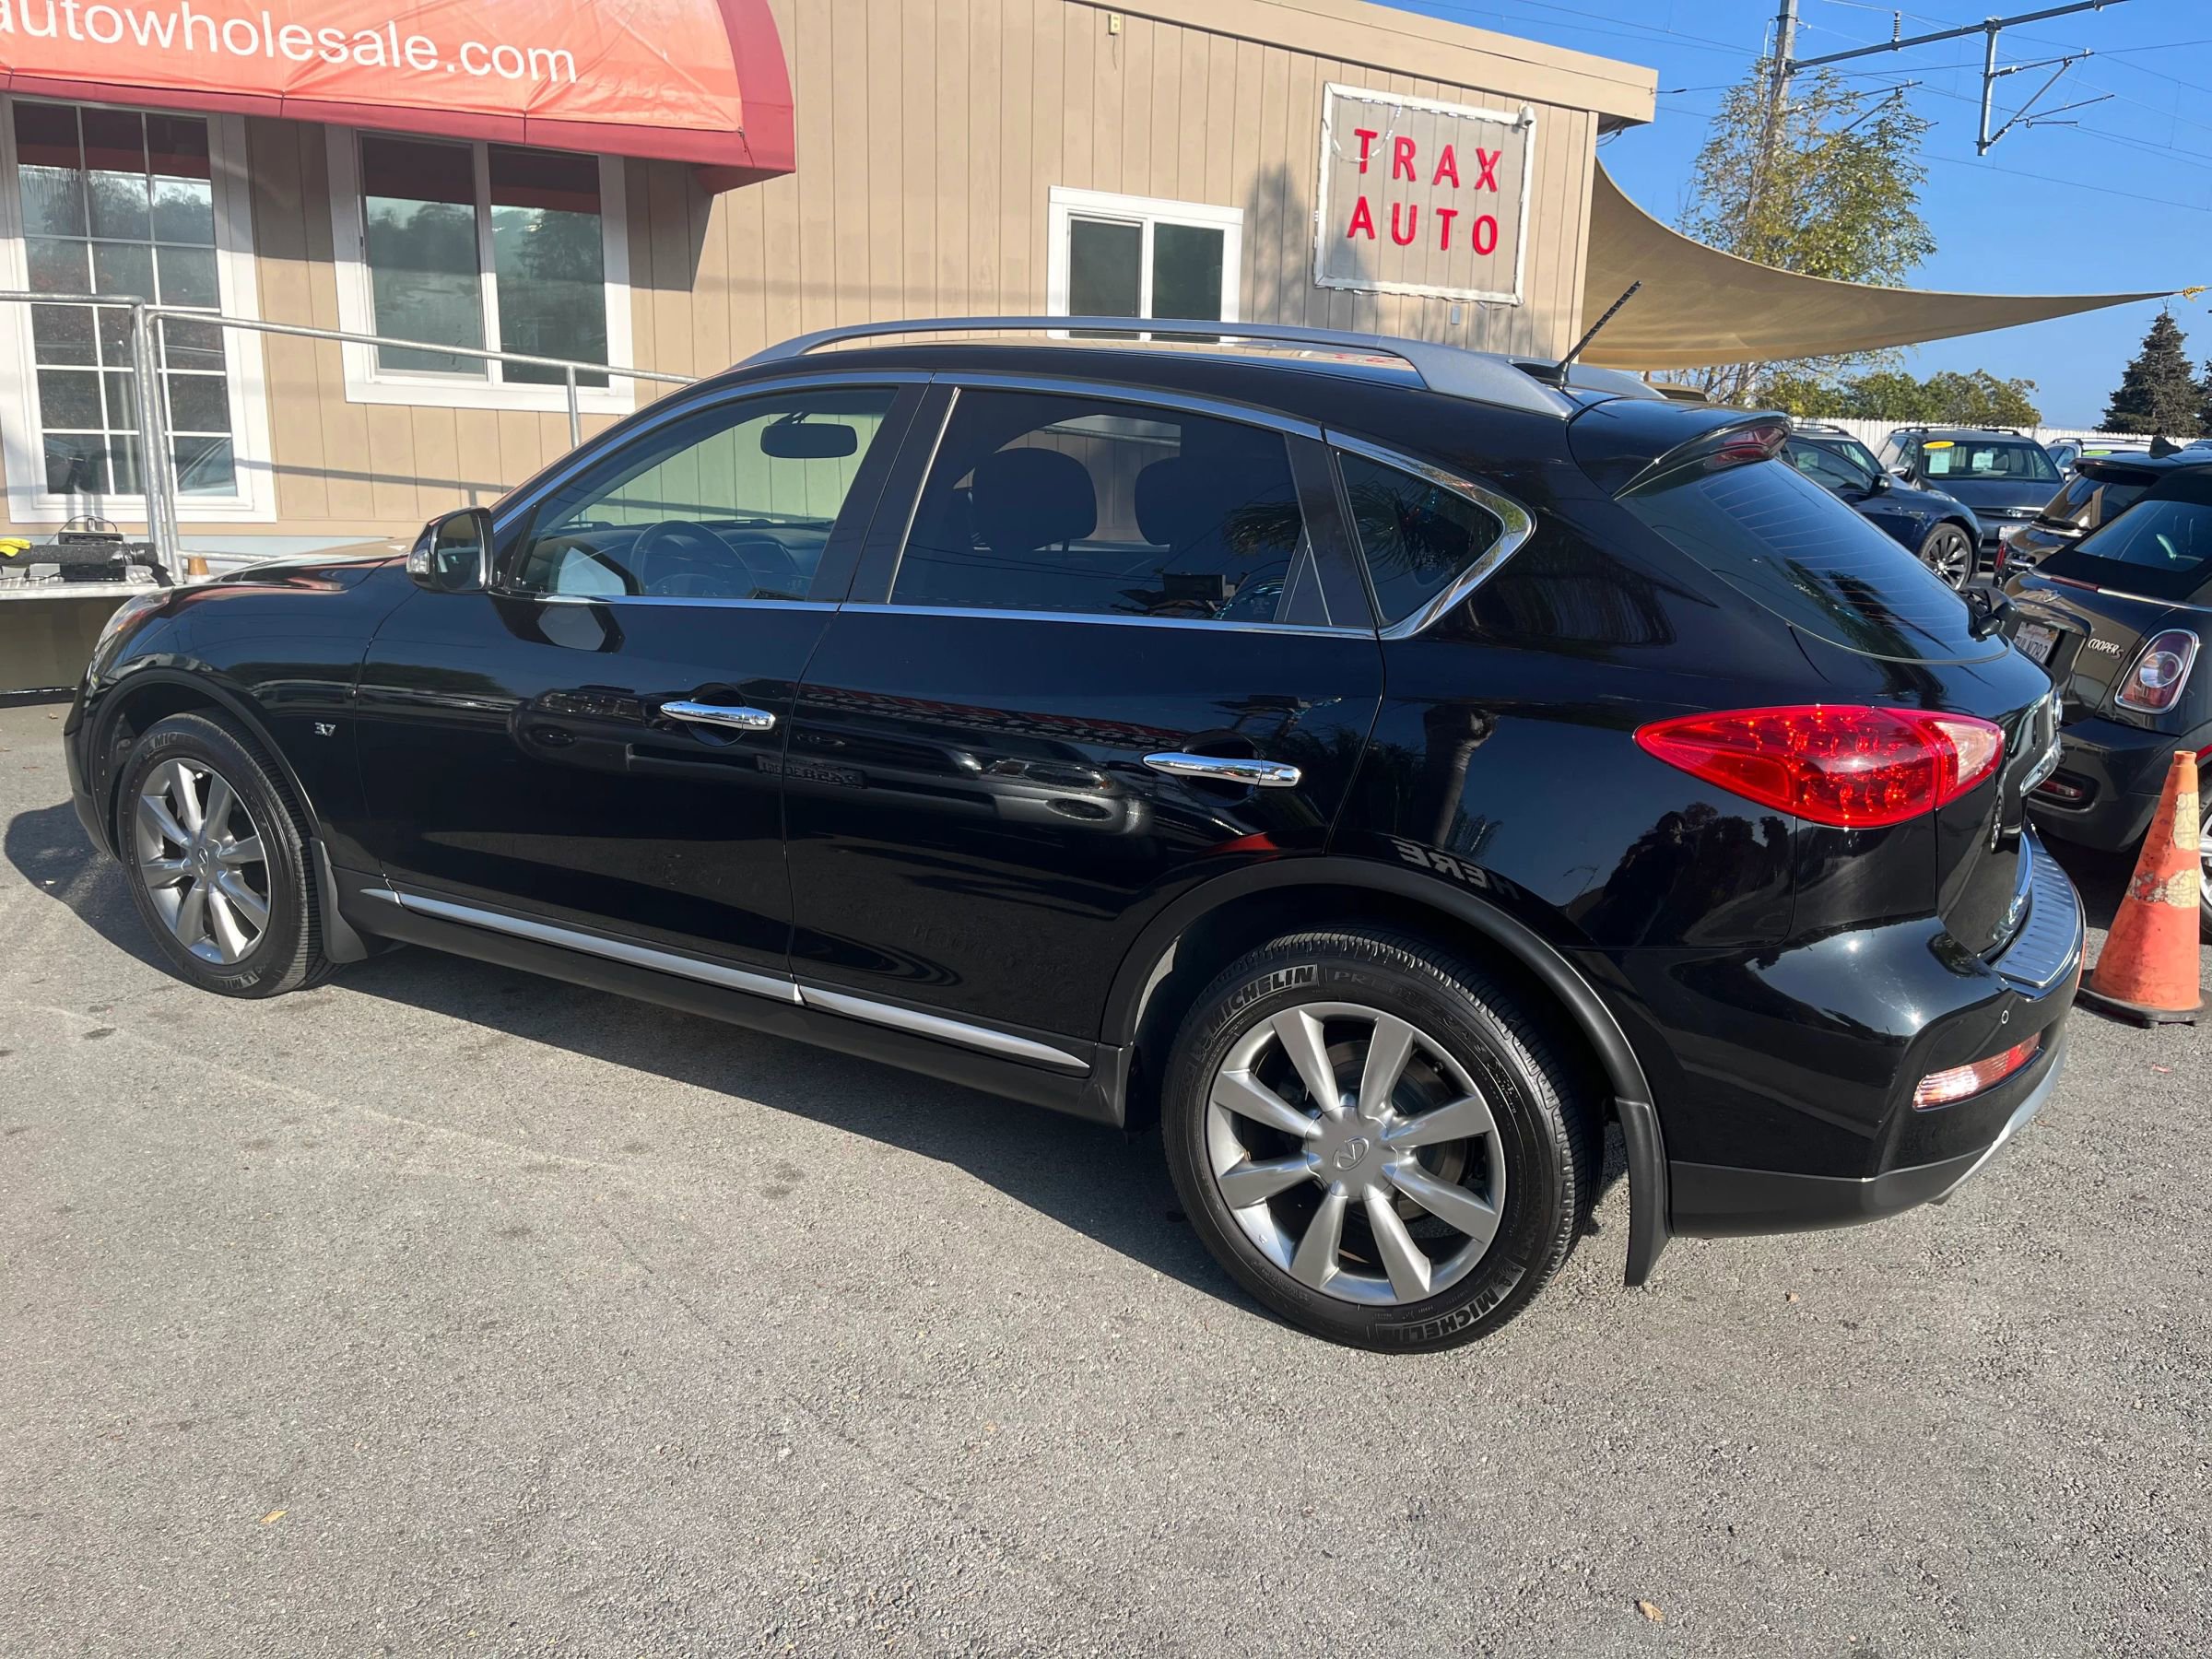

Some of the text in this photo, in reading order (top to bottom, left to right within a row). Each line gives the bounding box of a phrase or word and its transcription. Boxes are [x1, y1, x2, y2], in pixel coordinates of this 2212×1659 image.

[1353, 128, 1502, 193] TRAX
[1347, 195, 1499, 256] AUTO
[2088, 638, 2120, 655] COOPER
[1207, 966, 1314, 1035] MICHELIN
